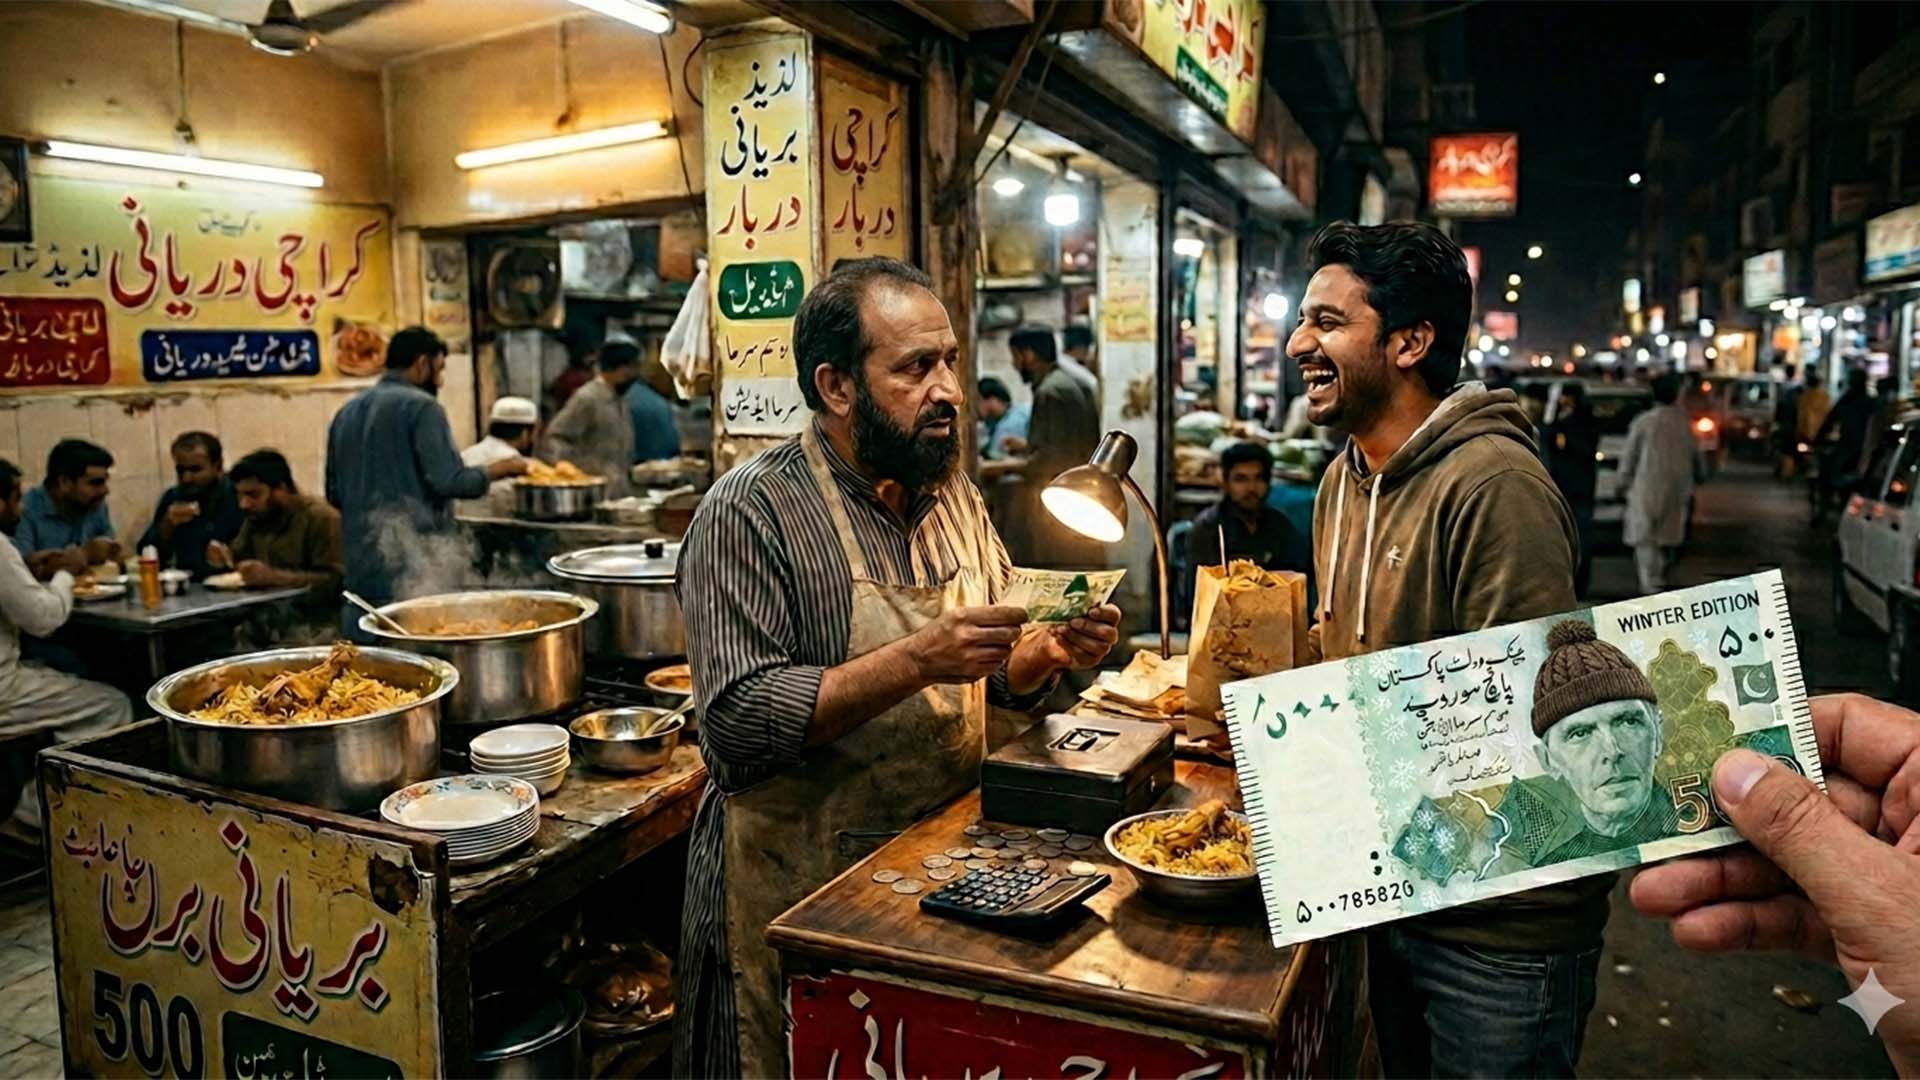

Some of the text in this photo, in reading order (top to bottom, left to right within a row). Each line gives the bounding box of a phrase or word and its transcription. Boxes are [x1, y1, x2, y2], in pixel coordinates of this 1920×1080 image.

[743, 51, 797, 109] لذیذ
[720, 104, 798, 178] بریانی
[831, 106, 901, 186] کراچی
[716, 183, 802, 250] دربار
[832, 182, 896, 251] دربار
[254, 218, 382, 321] کراچی
[1617, 590, 1761, 634] WINTER EDITION
[209, 820, 389, 1018] بریانی
[93, 969, 206, 1080] 500
